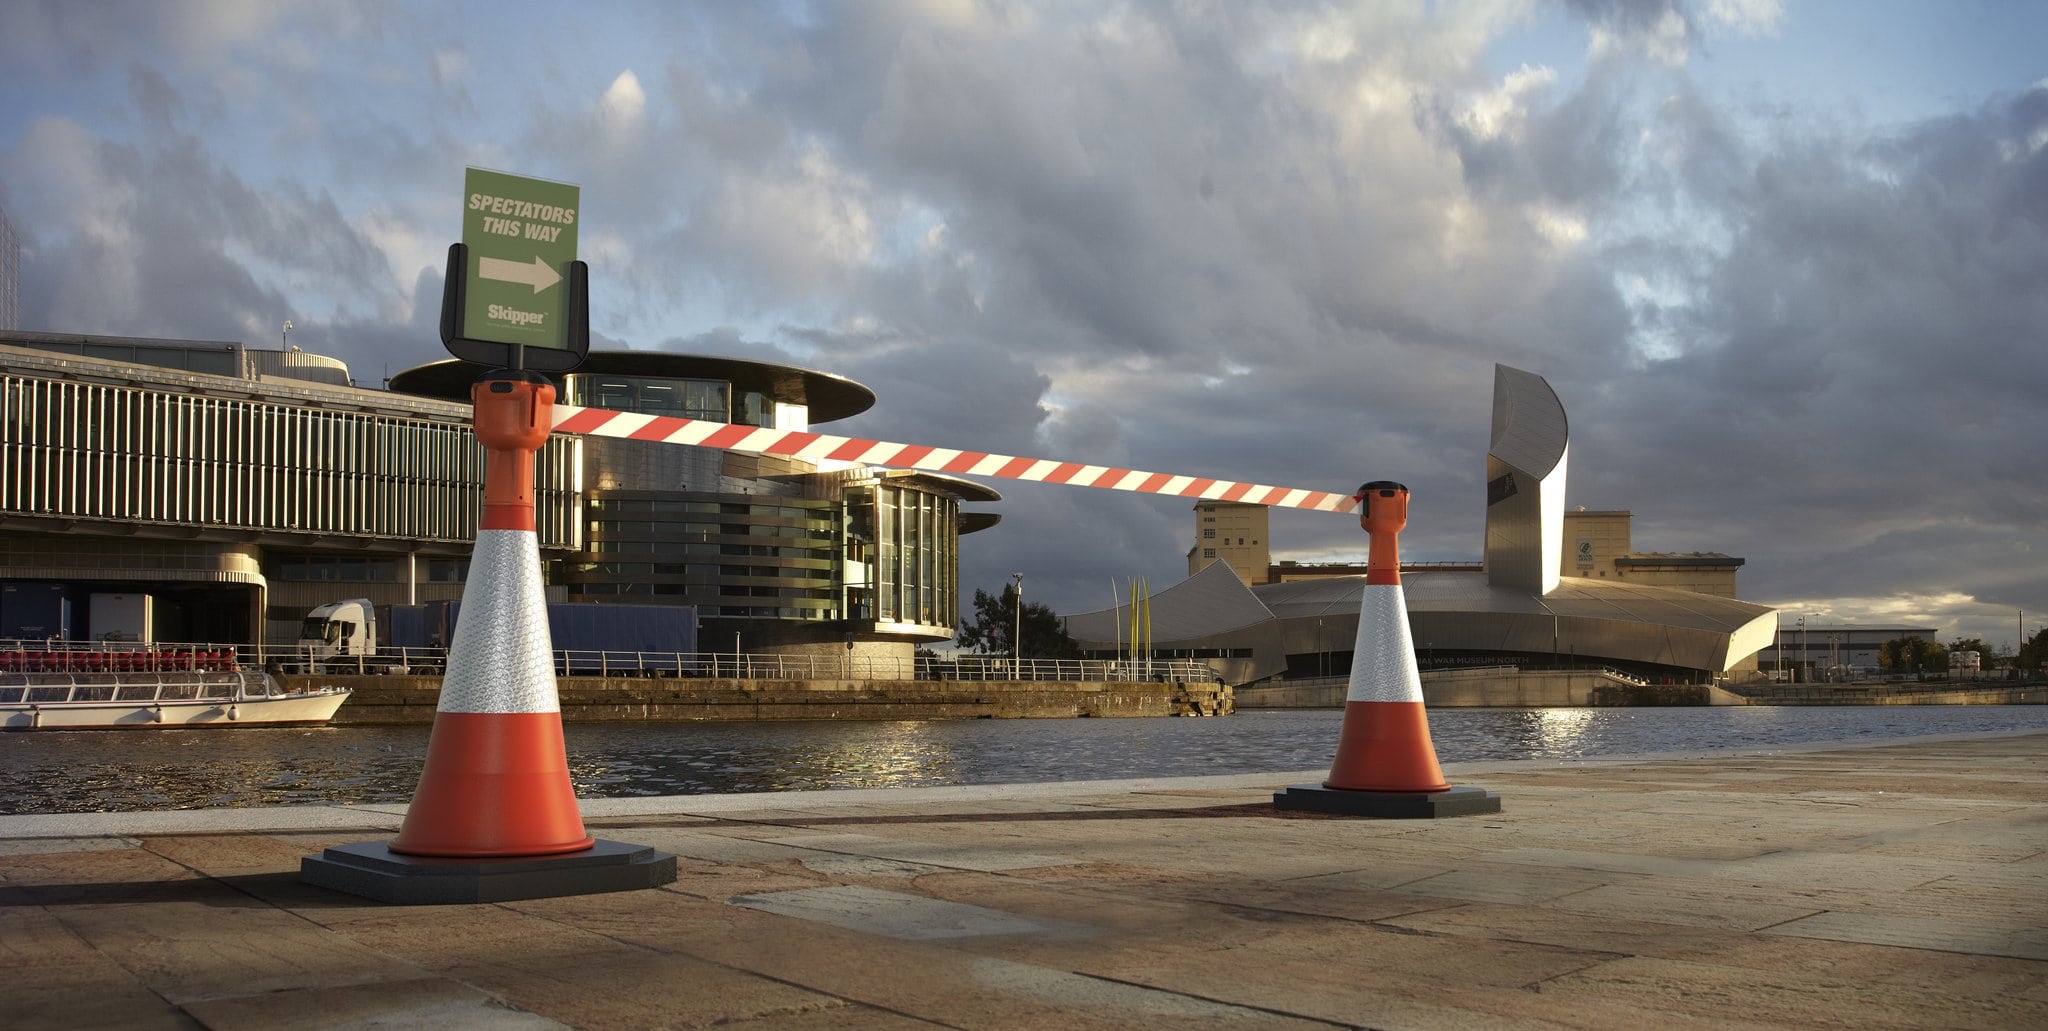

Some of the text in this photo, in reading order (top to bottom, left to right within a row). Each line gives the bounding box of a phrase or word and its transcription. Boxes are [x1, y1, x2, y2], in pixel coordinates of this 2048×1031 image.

[468, 193, 576, 225] SPECTATORS
[483, 216, 562, 243] THIS WAY
[488, 304, 544, 325] Skipper
[1497, 656, 1529, 664] NORTH
